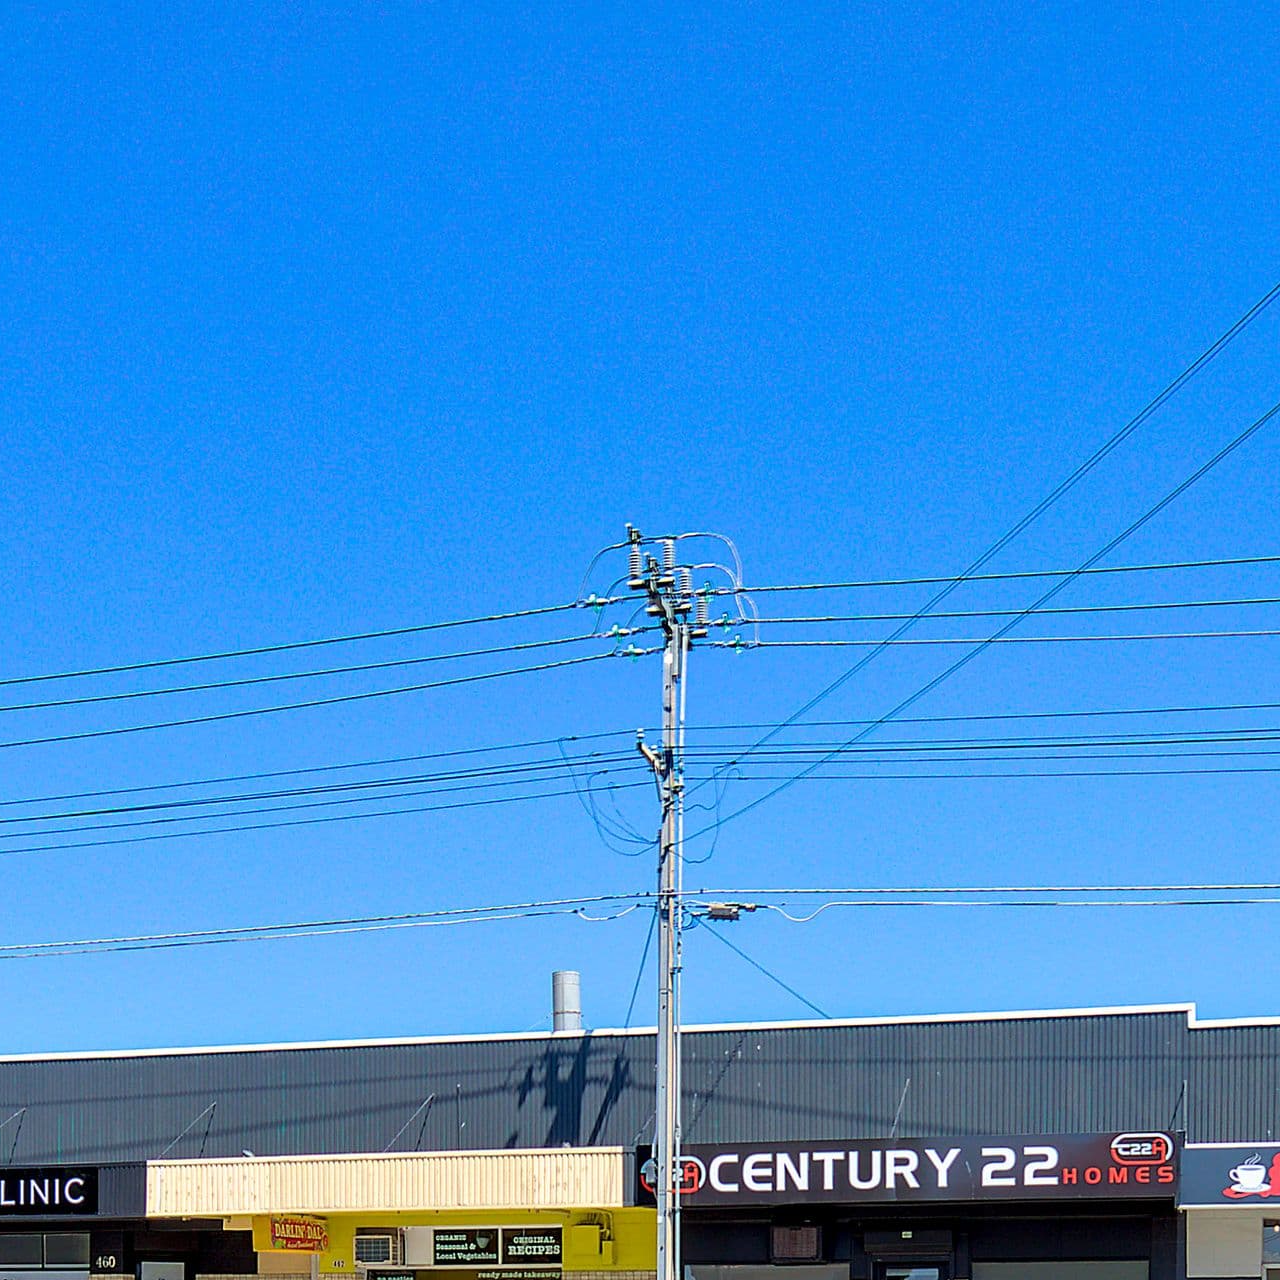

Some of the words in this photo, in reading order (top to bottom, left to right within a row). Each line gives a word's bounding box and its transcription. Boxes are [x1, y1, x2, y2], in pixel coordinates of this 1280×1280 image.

[709, 1150, 961, 1192] CENTURY
[981, 1147, 1059, 1187] 22
[1062, 1166, 1174, 1184] HOMES
[513, 1236, 555, 1244] ORIGINAL
[508, 1245, 560, 1255] RECIPES
[96, 1256, 116, 1268] 460
[458, 1252, 497, 1261] Vegetables
